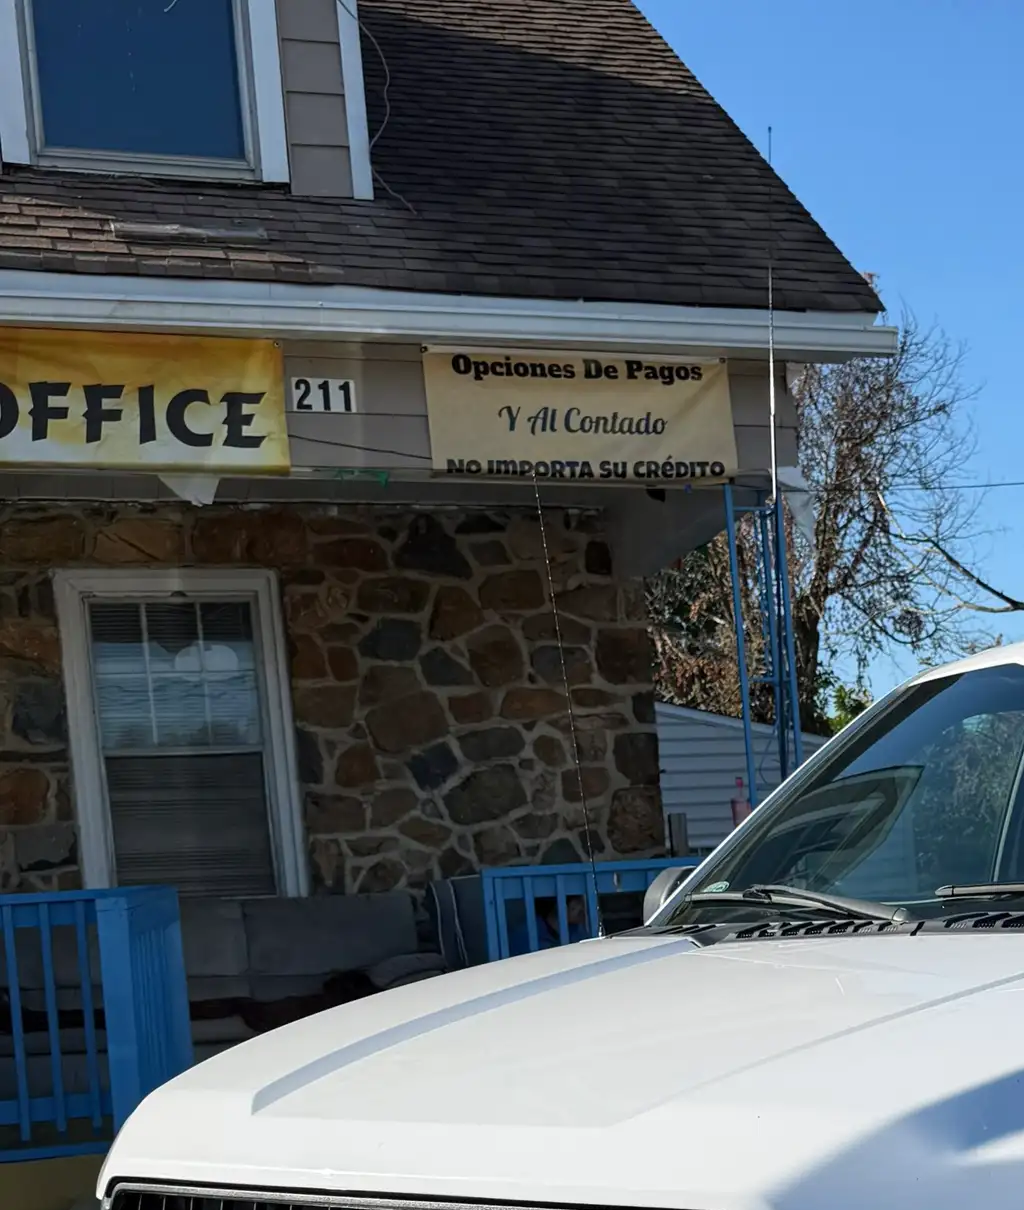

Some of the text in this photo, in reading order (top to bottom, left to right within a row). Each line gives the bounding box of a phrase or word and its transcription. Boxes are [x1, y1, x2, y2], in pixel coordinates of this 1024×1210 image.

[451, 354, 703, 385] Opciones De Pagos
[294, 379, 353, 412] 211
[498, 406, 667, 436] Y Al Contado
[446, 459, 482, 474] NO
